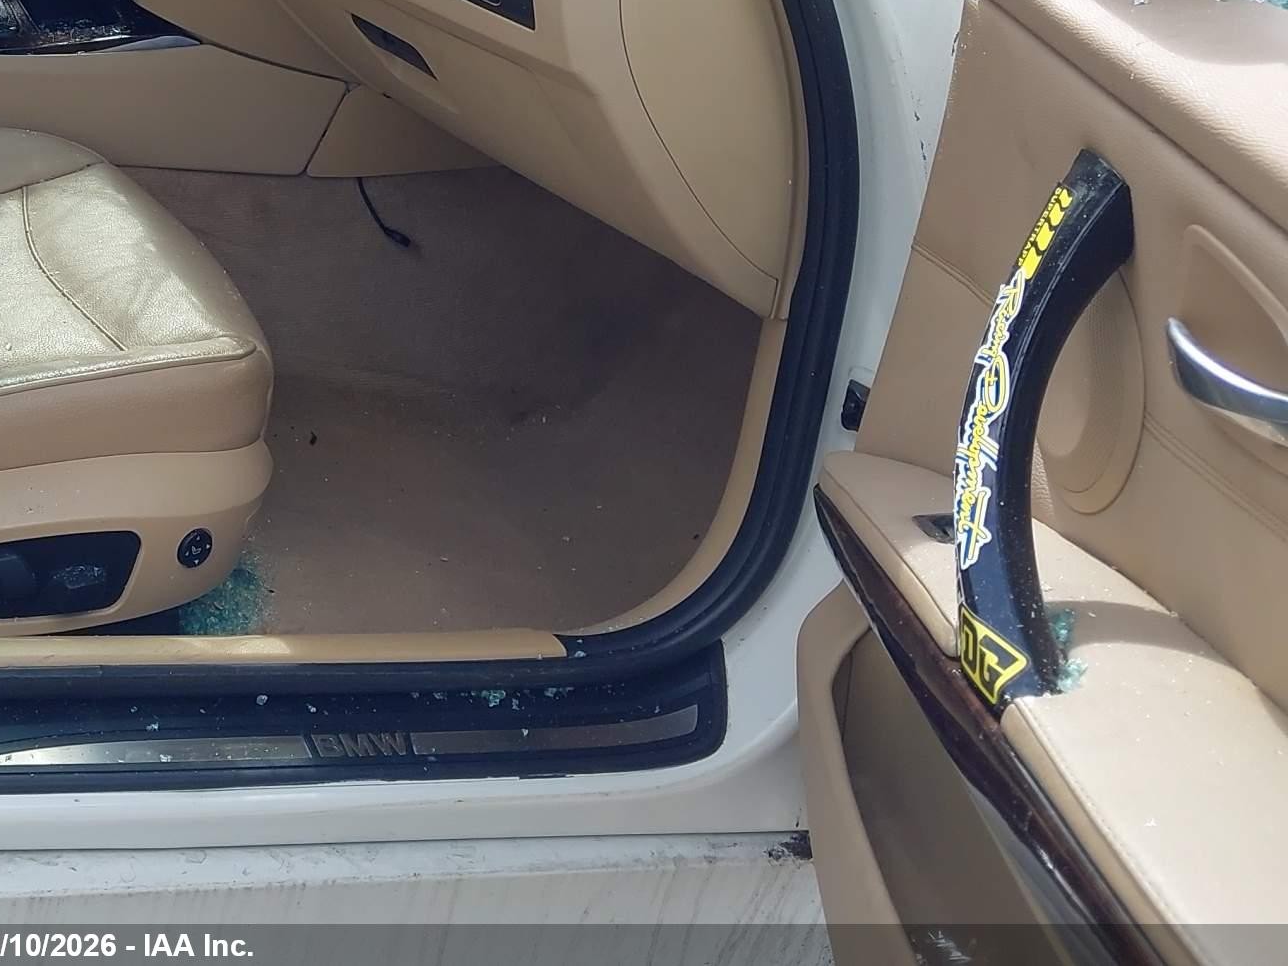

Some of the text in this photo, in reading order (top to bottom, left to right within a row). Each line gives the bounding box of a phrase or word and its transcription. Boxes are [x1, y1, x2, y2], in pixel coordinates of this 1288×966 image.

[1017, 186, 1062, 267] SUPERTRAPP
[976, 268, 1026, 363] Racing
[311, 732, 408, 757] BMW
